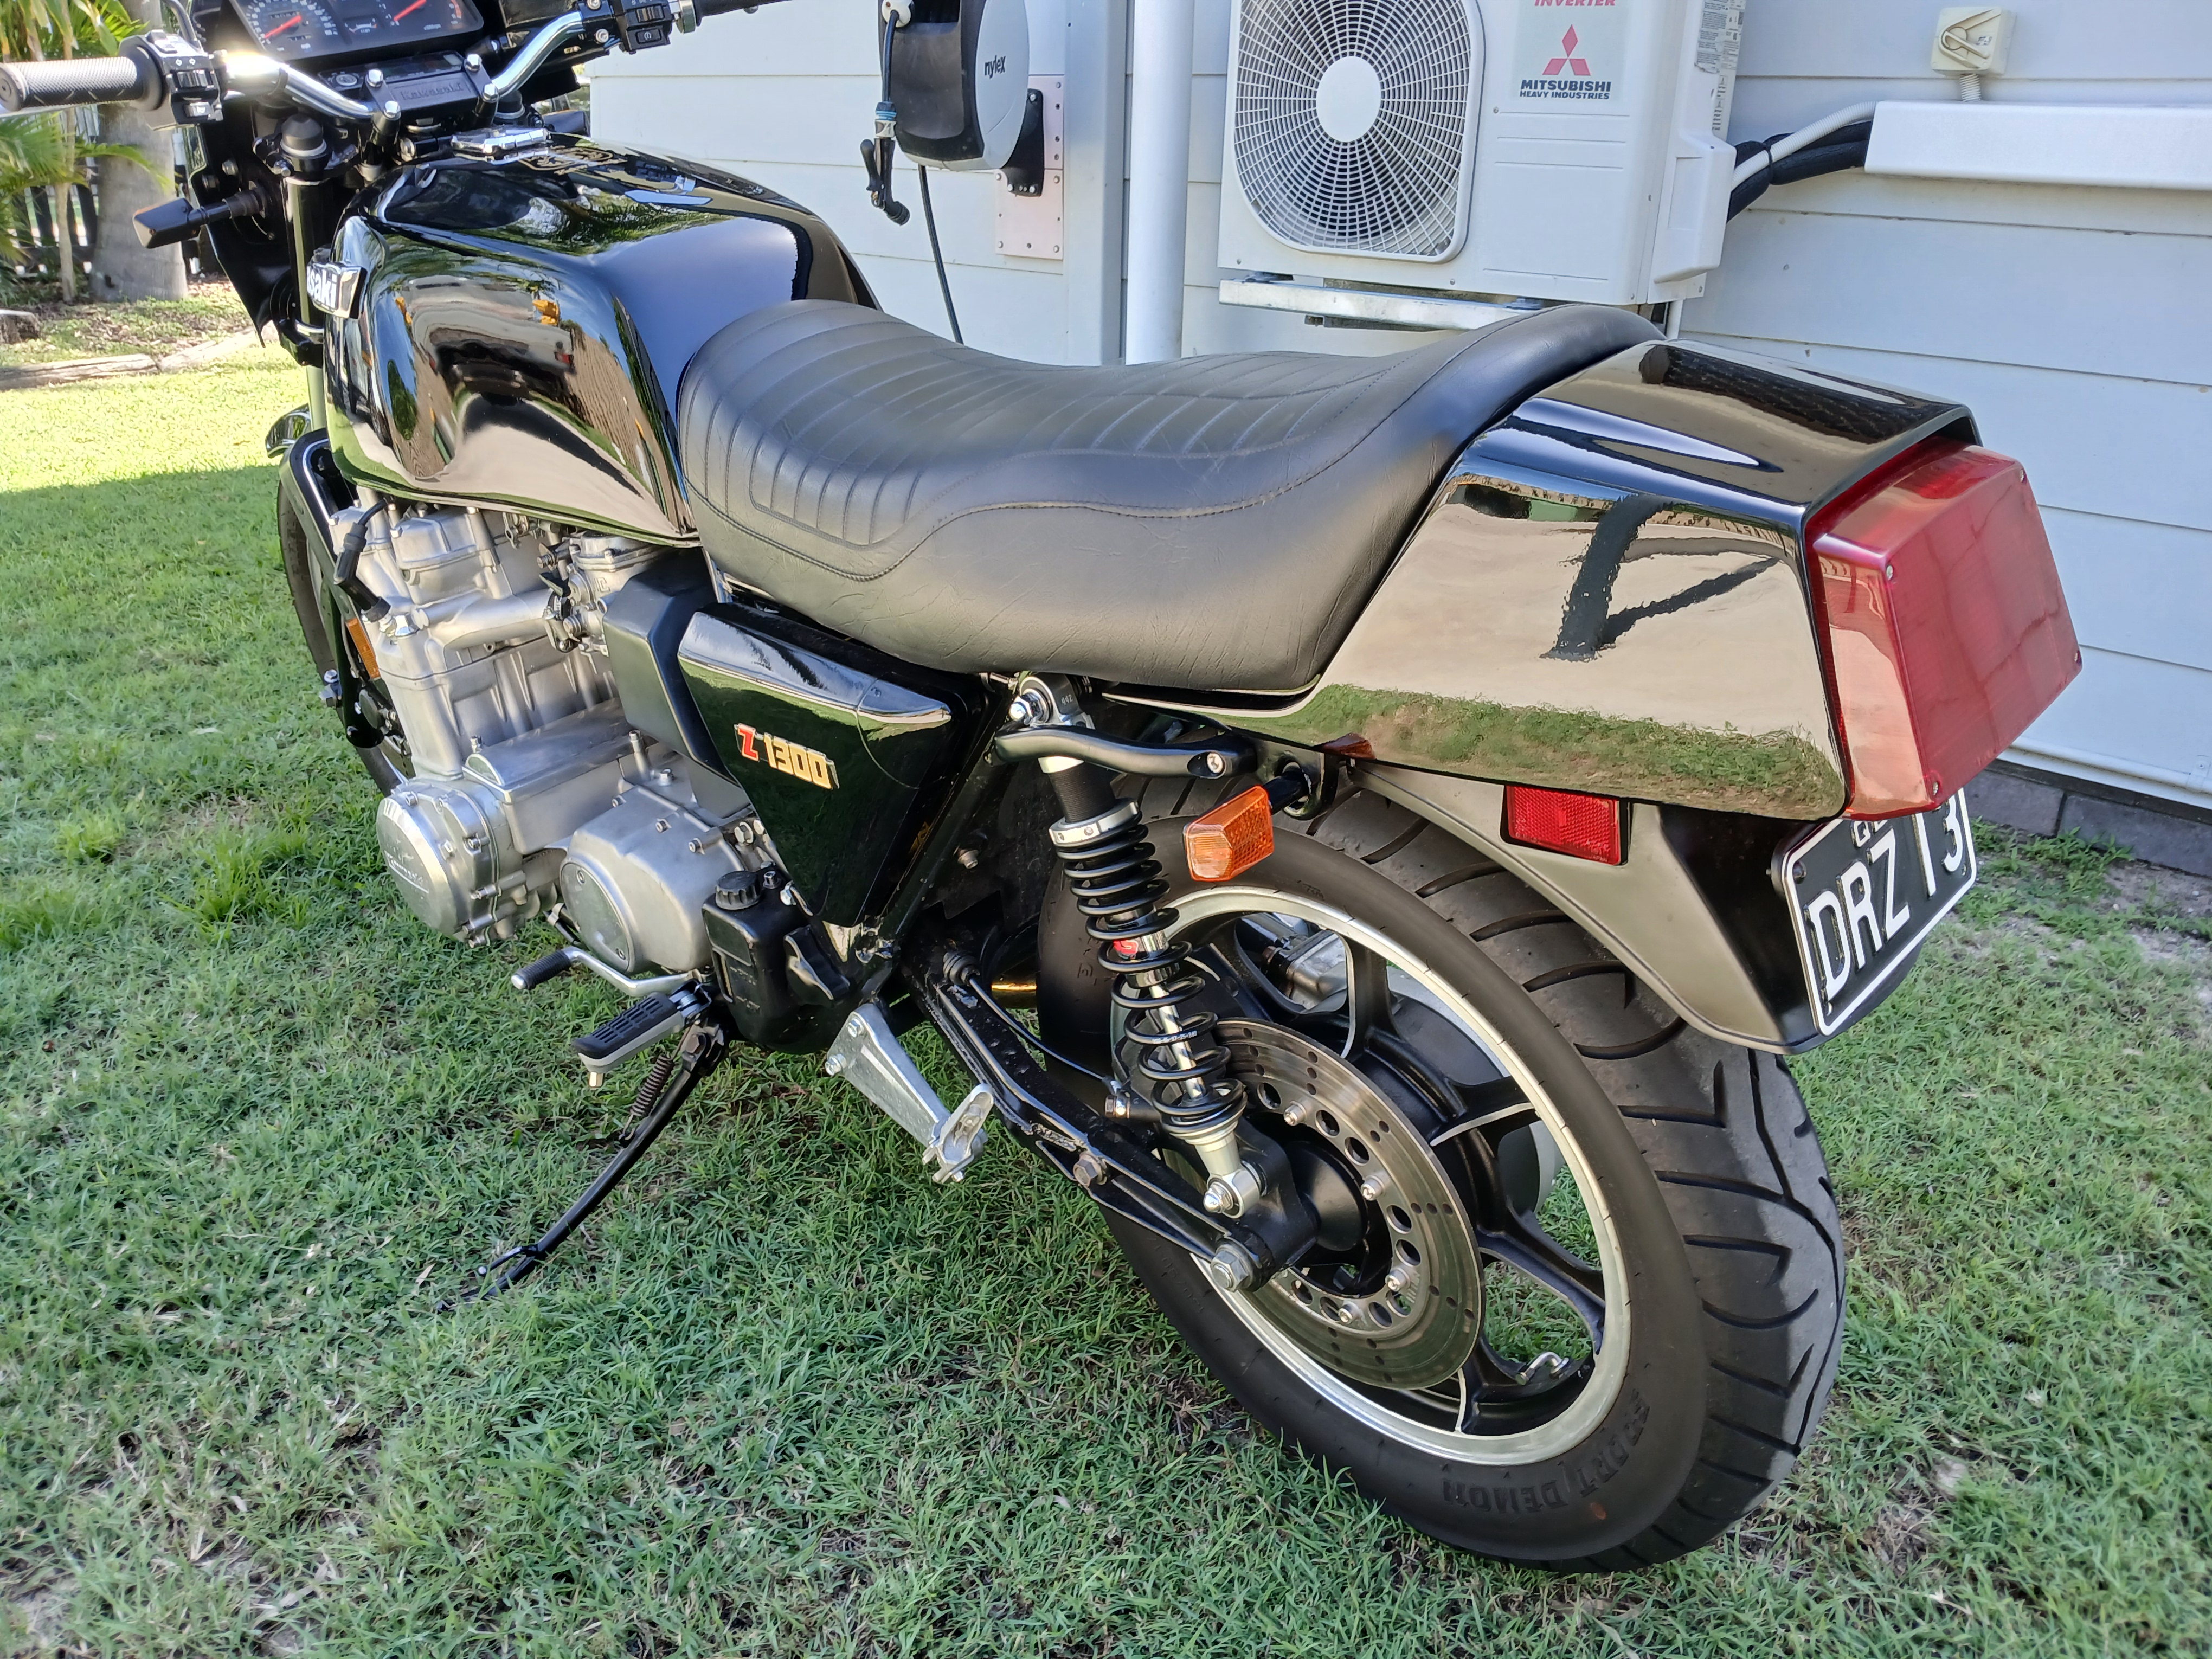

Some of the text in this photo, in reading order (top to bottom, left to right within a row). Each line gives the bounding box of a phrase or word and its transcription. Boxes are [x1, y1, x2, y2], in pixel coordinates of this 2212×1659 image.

[985, 55, 1006, 79] nylex
[1521, 80, 1612, 92] MITSUBISHI
[1551, 91, 1610, 100] INDUSTRIES
[1442, 1479, 1569, 1515] DEMON
